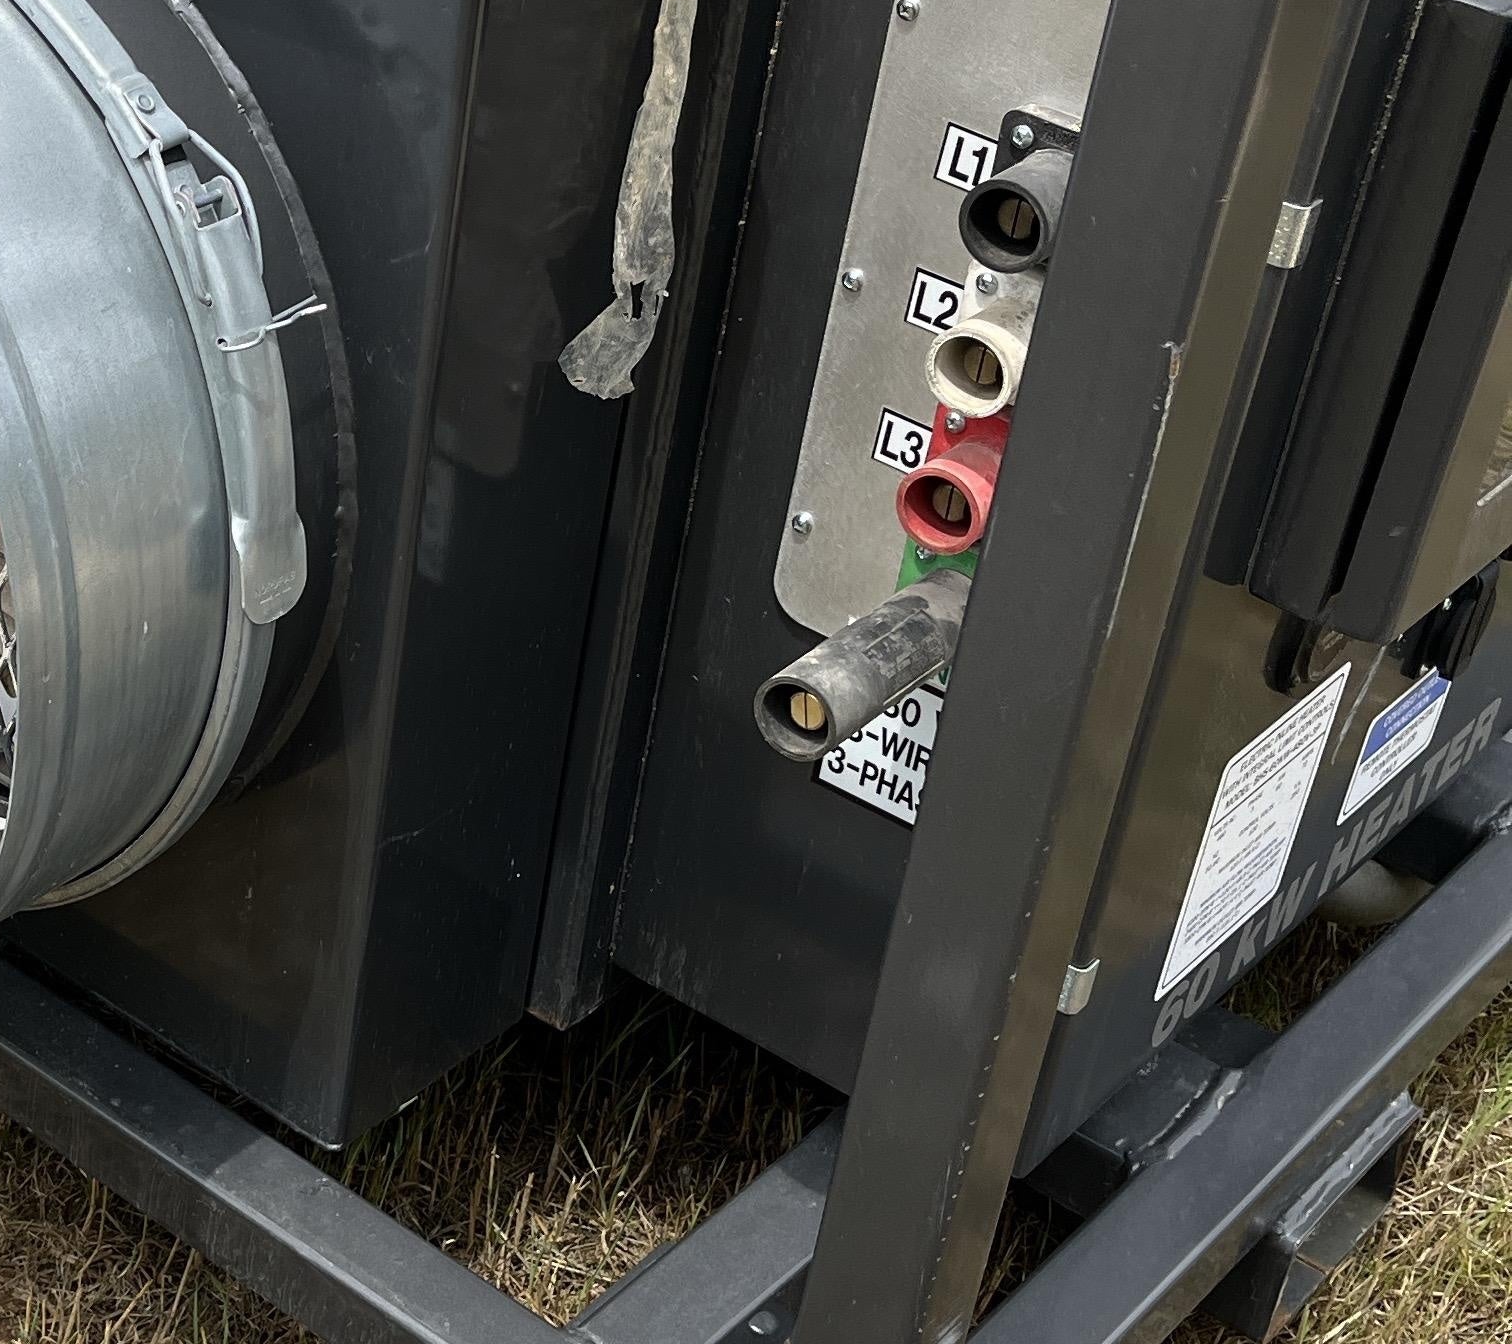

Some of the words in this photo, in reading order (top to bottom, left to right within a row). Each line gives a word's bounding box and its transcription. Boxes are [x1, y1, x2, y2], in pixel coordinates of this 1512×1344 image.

[948, 136, 990, 186] L1
[912, 280, 960, 331] L2
[880, 420, 924, 469] L3
[827, 746, 920, 811] 3-PHA
[1152, 952, 1220, 1048] 60
[1318, 696, 1503, 898] HEATER
